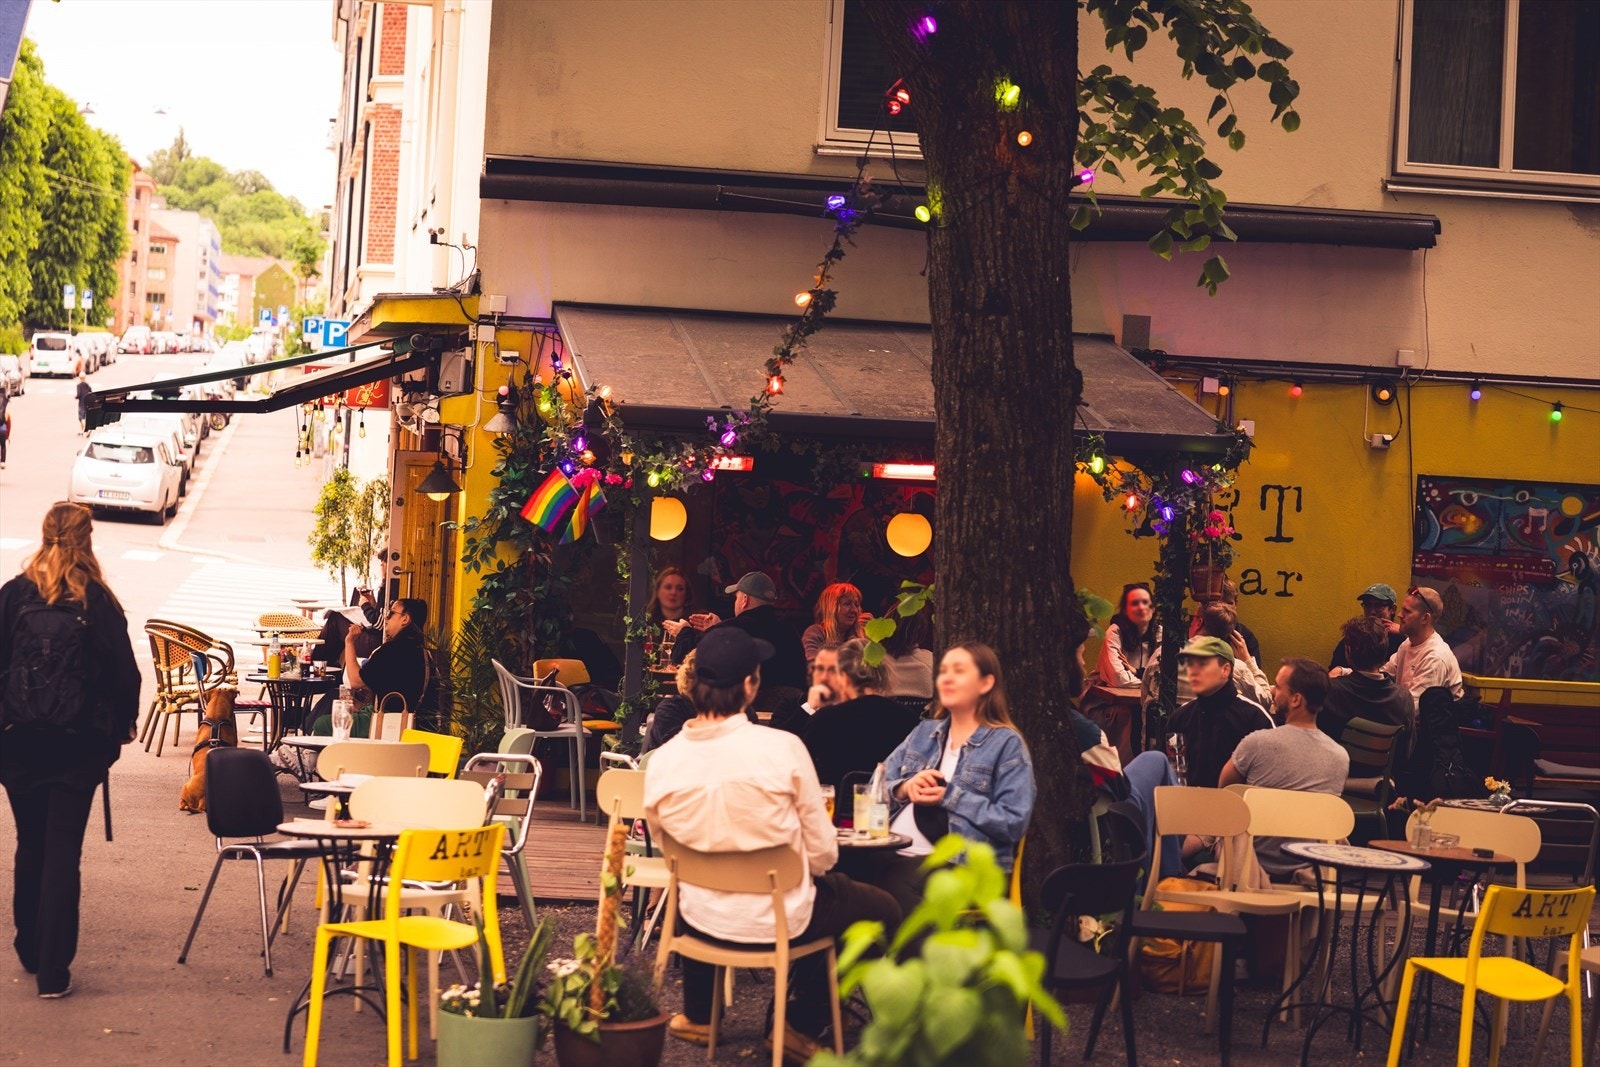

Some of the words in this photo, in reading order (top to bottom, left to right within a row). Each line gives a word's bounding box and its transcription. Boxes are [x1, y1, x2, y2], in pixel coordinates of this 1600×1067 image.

[262, 310, 270, 320] P
[307, 320, 317, 332] P
[329, 323, 345, 345] P
[429, 831, 490, 860] ART
[1512, 893, 1577, 918] ART
[1543, 925, 1565, 936] bar
